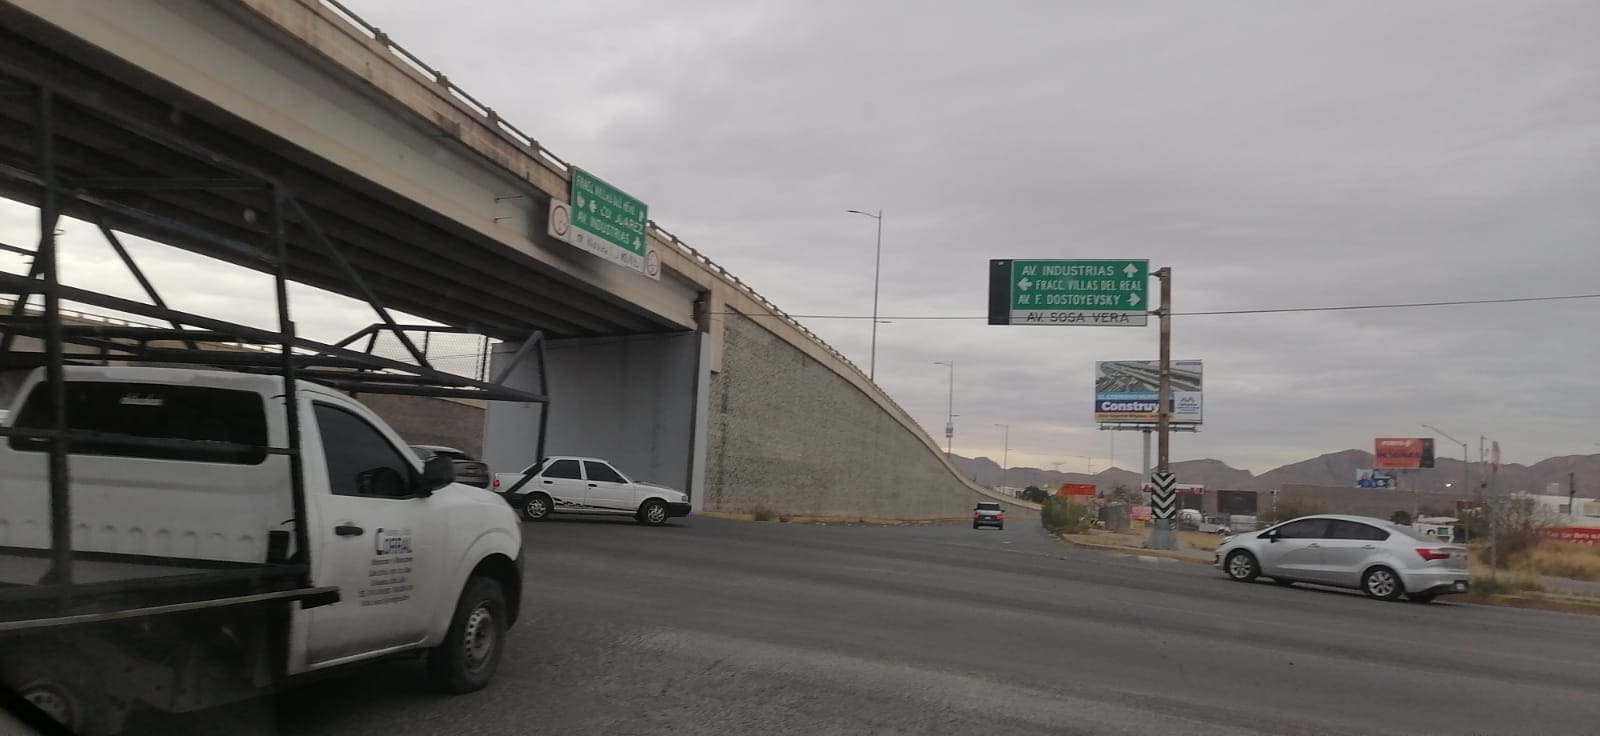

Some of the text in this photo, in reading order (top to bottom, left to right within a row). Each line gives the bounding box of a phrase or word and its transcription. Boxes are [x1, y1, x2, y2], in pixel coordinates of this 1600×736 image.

[1042, 265, 1114, 276] INDUSTRIAS
[1068, 279, 1099, 291] VILLAS
[1100, 279, 1117, 291] DEL
[1120, 279, 1143, 291] REAL
[1046, 294, 1121, 305] DOSTOYEVSKY
[1049, 312, 1085, 323] SOSA
[1091, 312, 1130, 323] VERA
[1101, 401, 1160, 414] Construy
